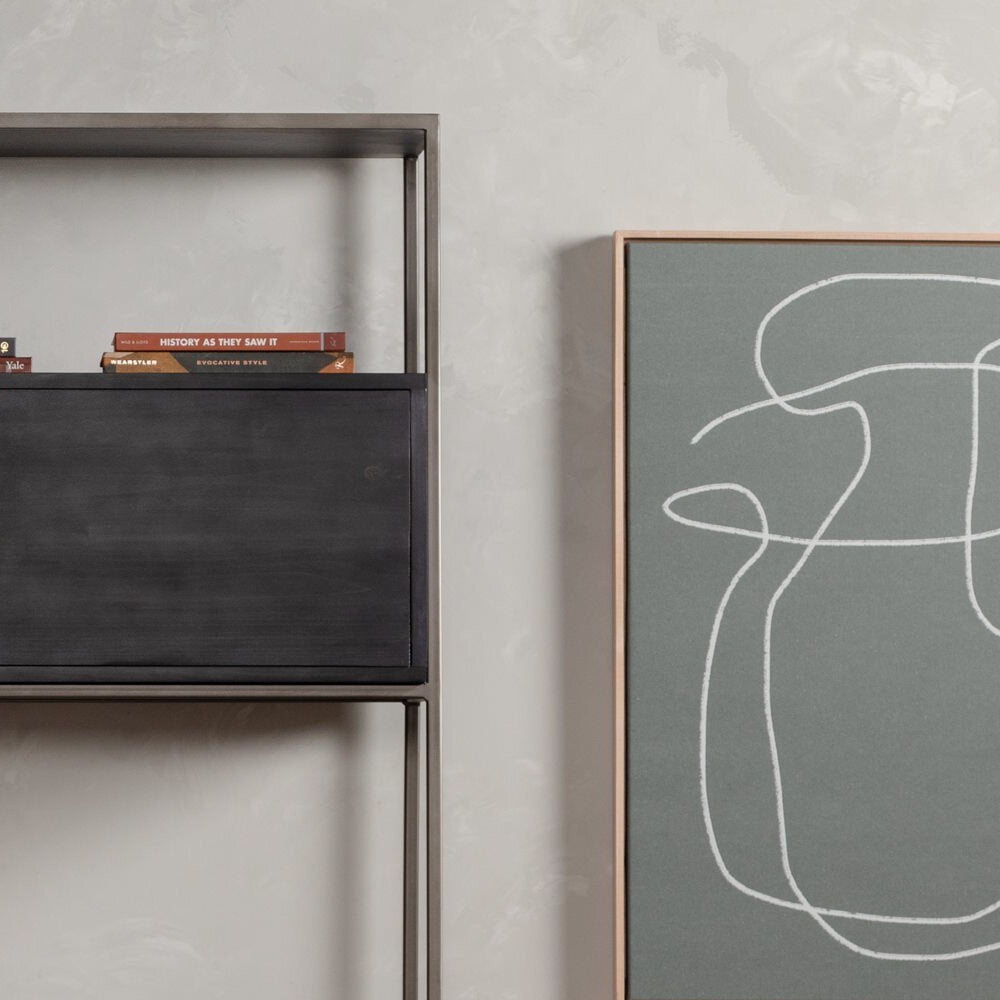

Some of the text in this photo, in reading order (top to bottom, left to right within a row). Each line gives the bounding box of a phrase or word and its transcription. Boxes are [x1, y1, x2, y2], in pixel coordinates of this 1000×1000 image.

[160, 338, 278, 347] HISTORY AS THEY SAW IT
[6, 361, 25, 370] Yale
